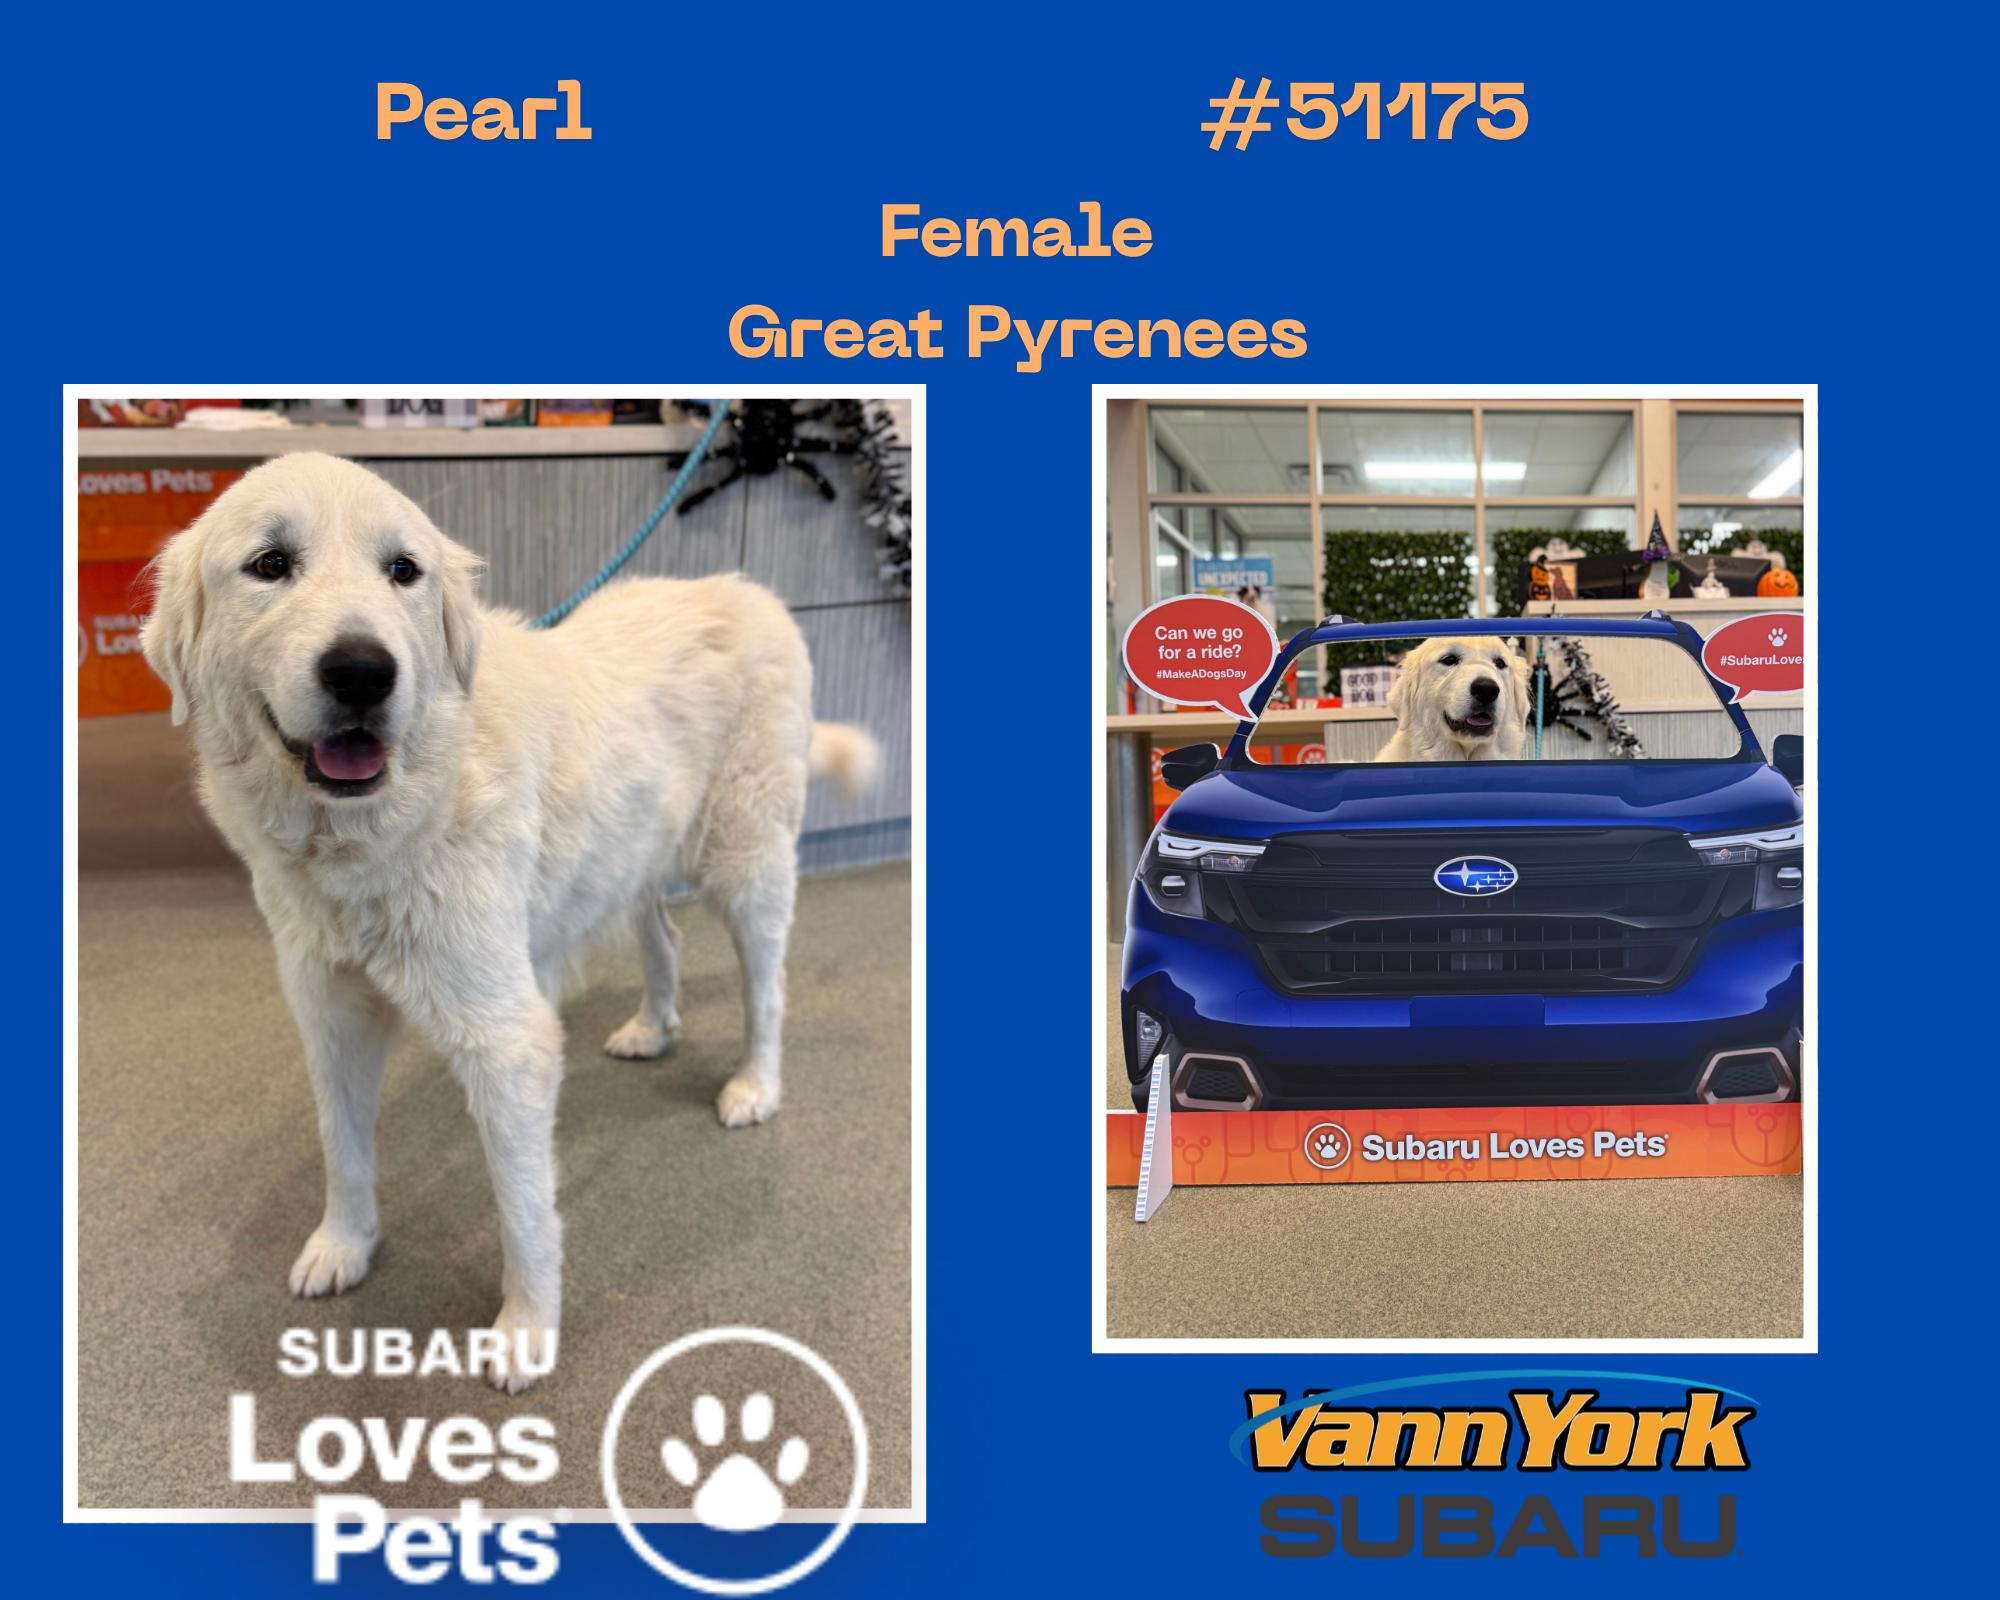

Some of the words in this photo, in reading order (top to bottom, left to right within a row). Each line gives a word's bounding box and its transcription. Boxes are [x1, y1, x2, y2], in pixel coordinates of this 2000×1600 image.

[78, 472, 147, 494] oves
[152, 469, 213, 493] Pets
[1154, 625, 1188, 641] Can
[1193, 628, 1217, 640] we
[1222, 627, 1244, 643] go
[1158, 645, 1182, 660] for
[1186, 648, 1197, 659] a
[1201, 643, 1242, 659] ride?
[1156, 668, 1247, 681] #MakeADogsDay
[1362, 1134, 1480, 1161] Subaru
[1490, 1132, 1585, 1159] Loves
